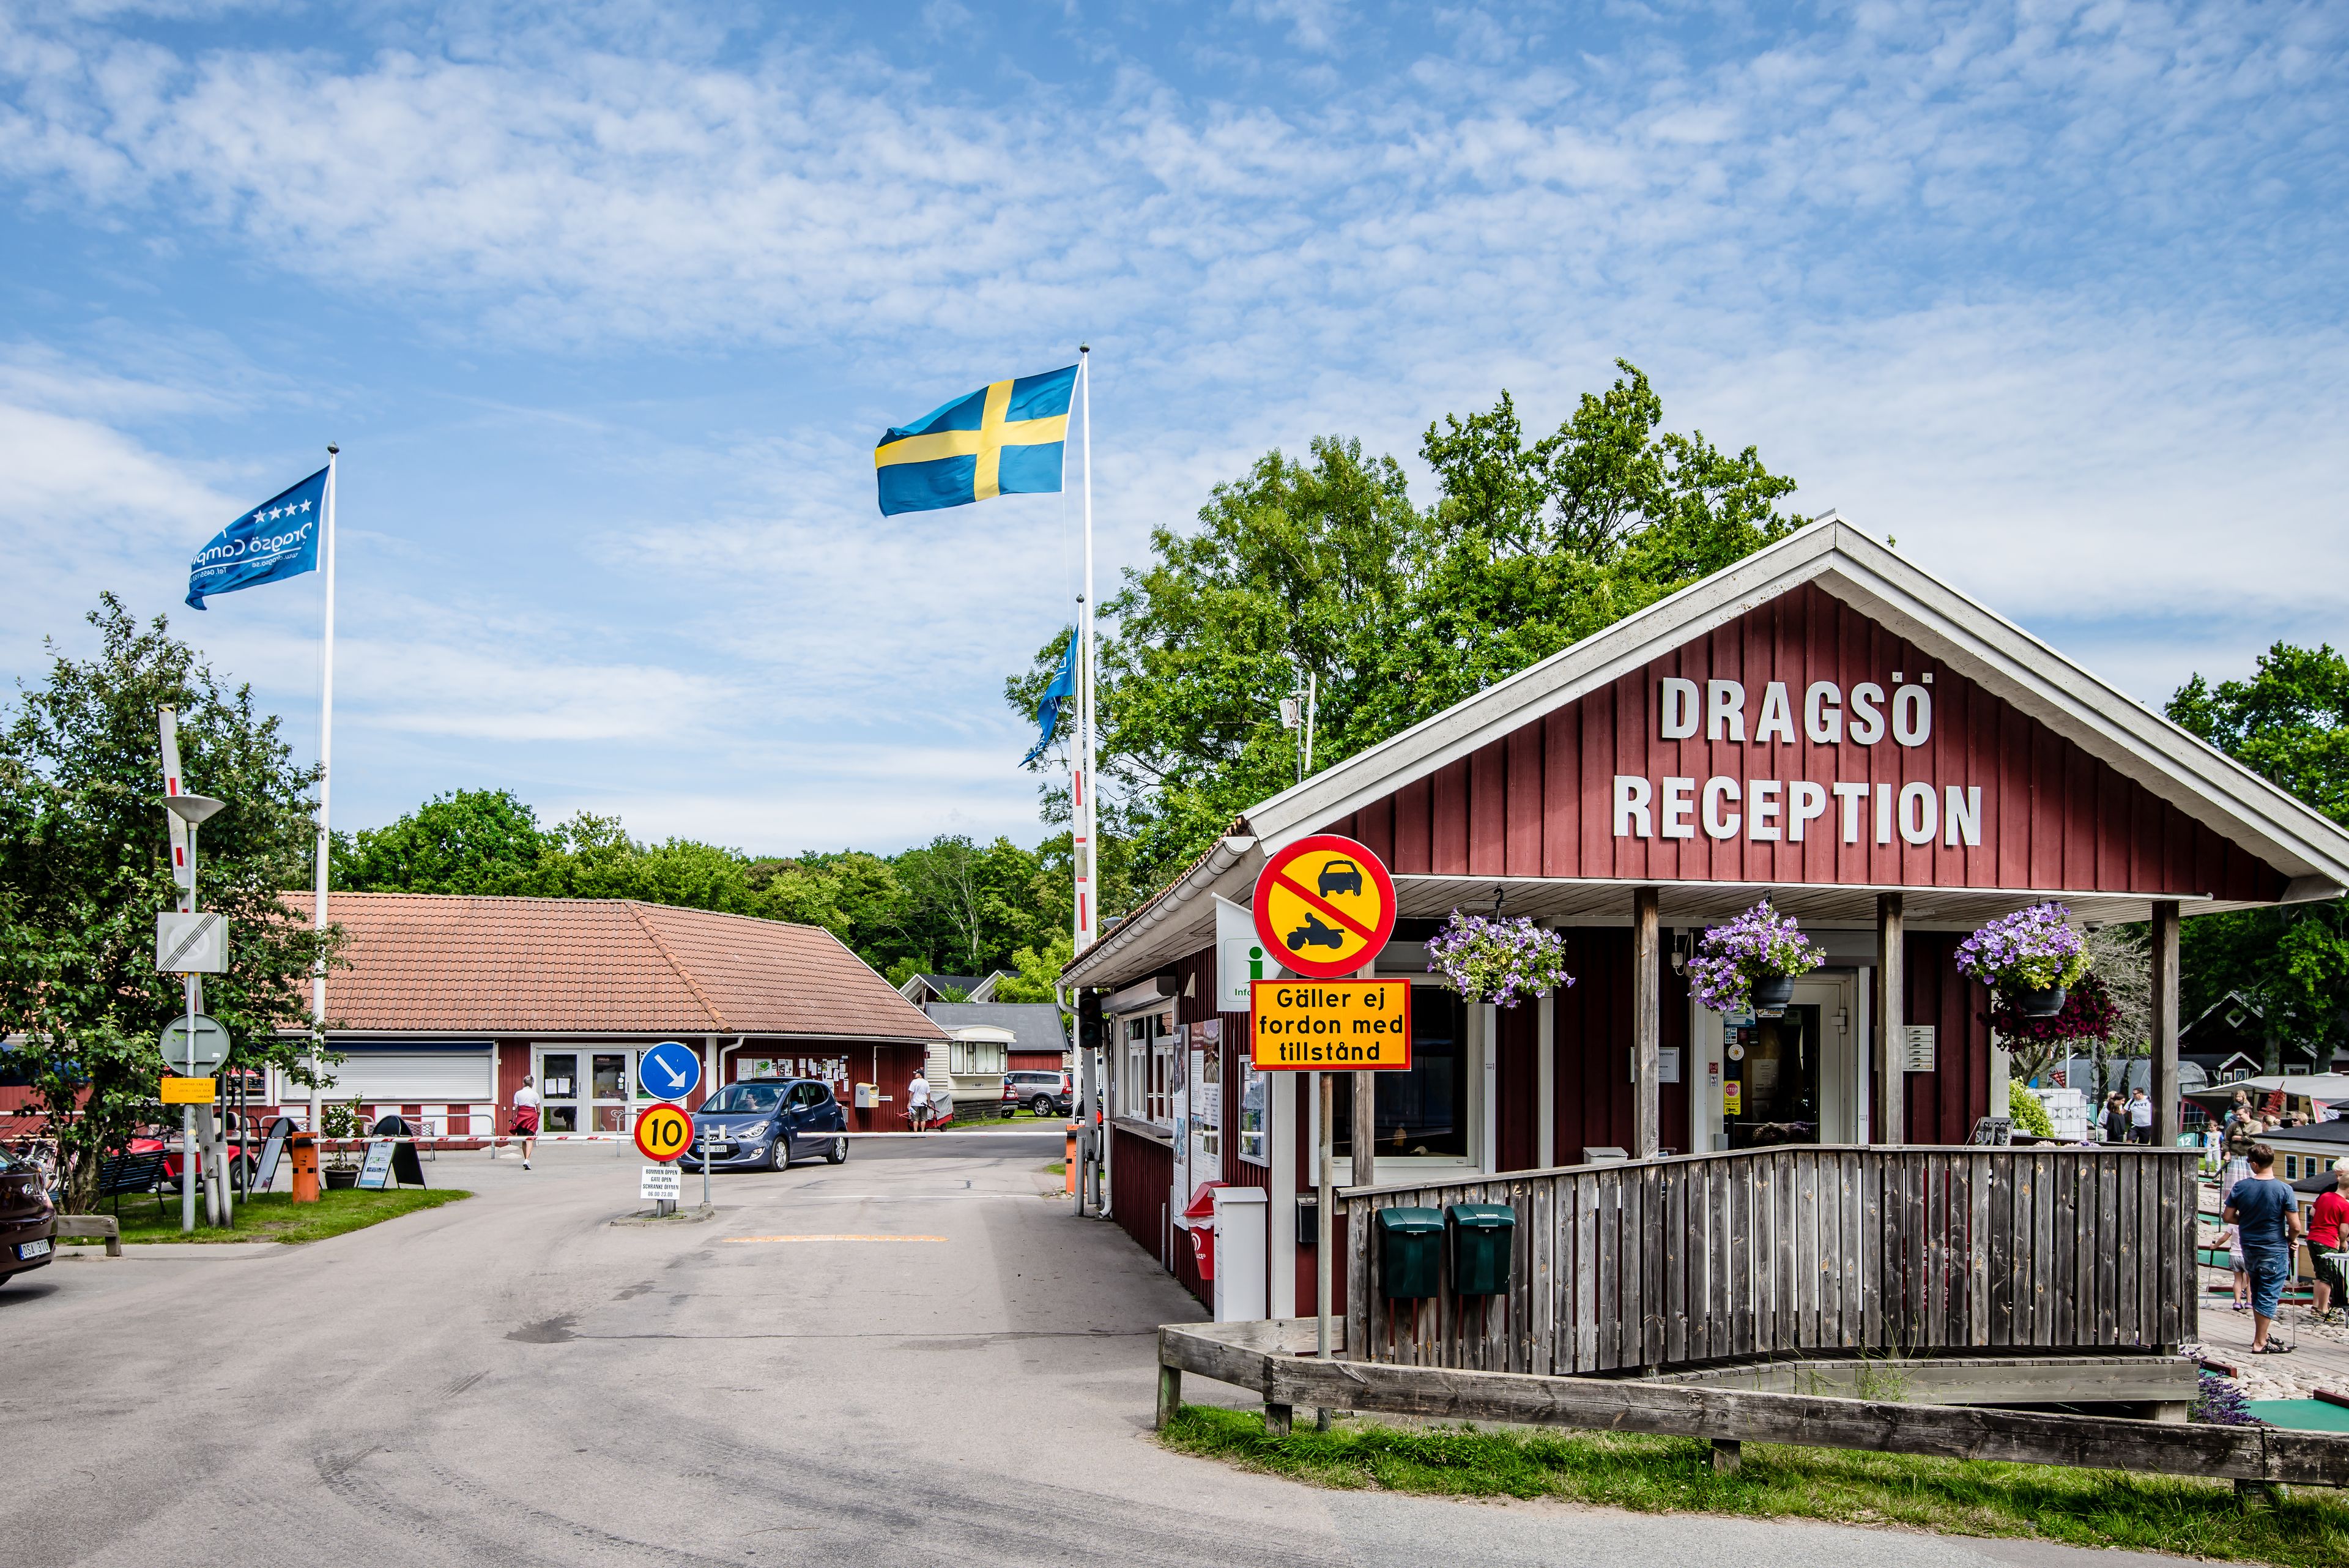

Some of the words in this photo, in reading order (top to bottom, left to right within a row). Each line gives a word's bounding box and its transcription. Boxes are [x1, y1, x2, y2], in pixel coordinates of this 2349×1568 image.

[1661, 671, 1934, 748] DRAGSÖ
[1613, 775, 1982, 847] RECEPTION
[1277, 988, 1351, 1008] Gäller
[1364, 987, 1385, 1011] ej
[1259, 1014, 1341, 1035] fordon
[1353, 1014, 1403, 1034] med
[1279, 1041, 1380, 1061] tillstånd
[651, 1118, 683, 1147] 10
[2179, 1137, 2191, 1146] 12
[23, 1244, 35, 1256] OSA
[37, 1240, 48, 1253] 310
